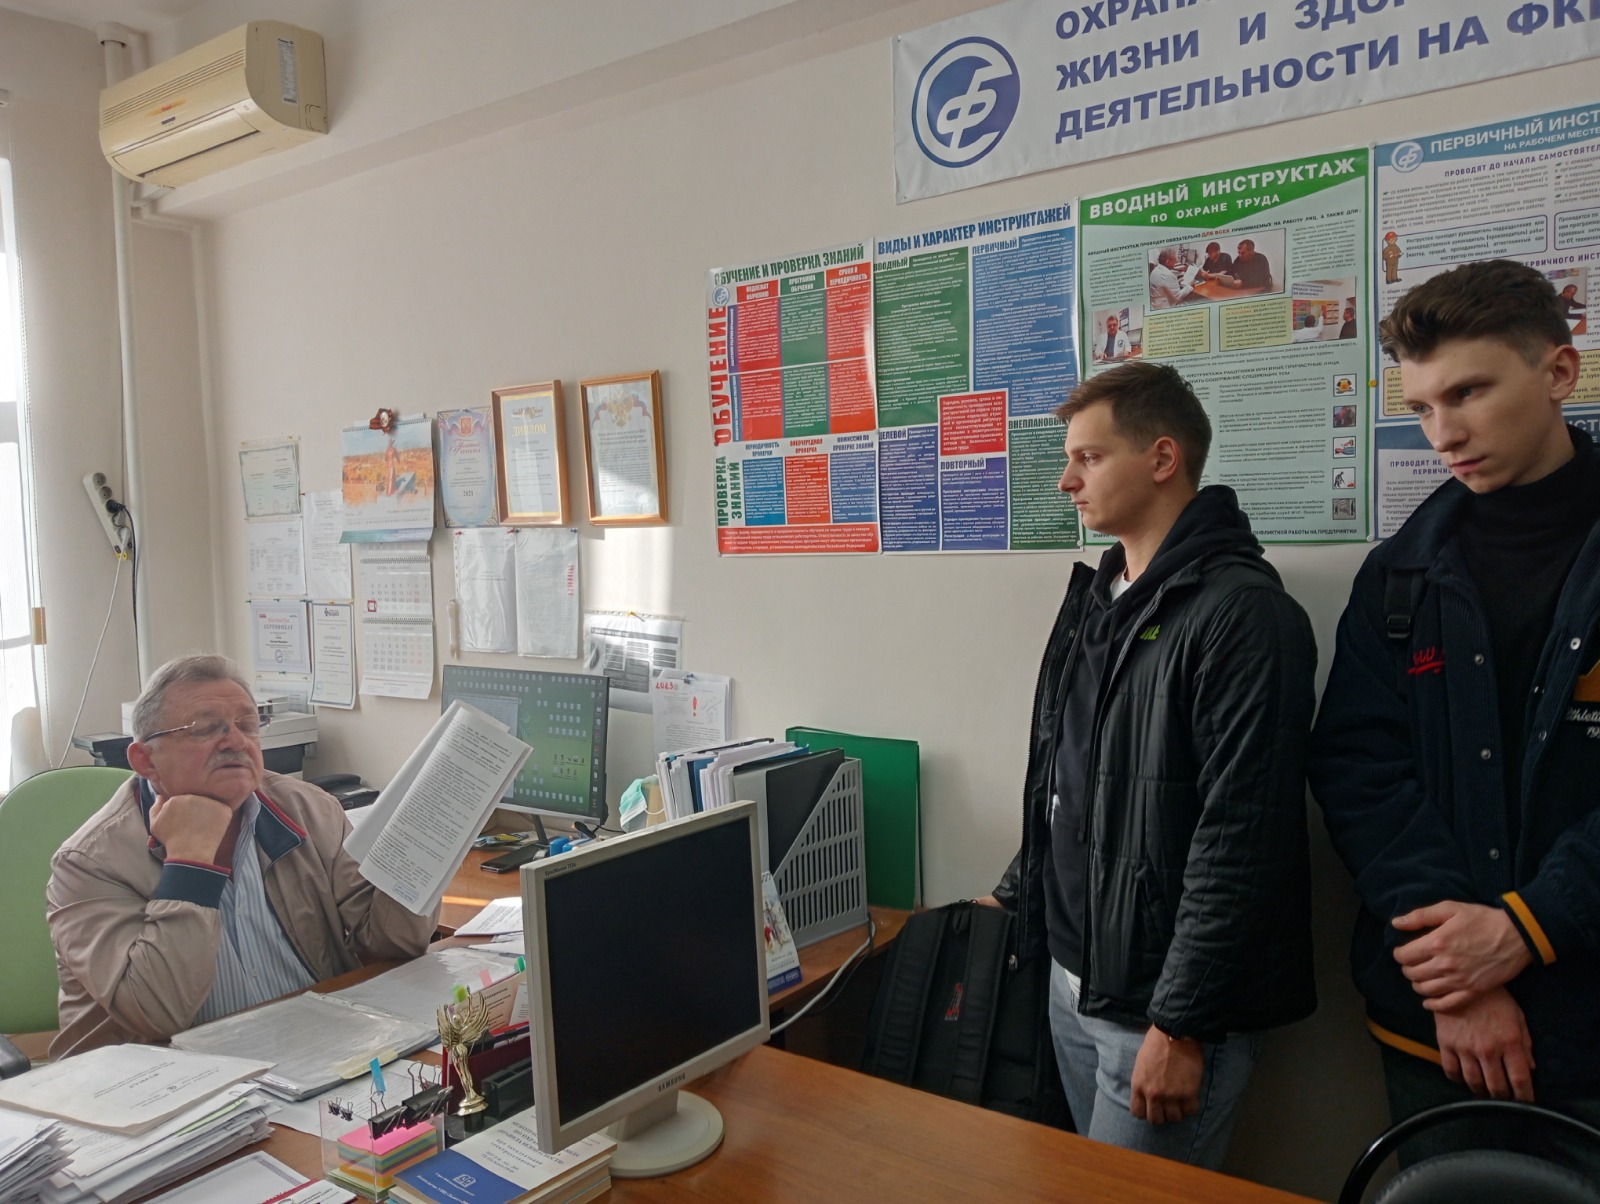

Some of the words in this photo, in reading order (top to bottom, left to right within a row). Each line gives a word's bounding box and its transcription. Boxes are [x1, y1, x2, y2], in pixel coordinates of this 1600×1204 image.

[1055, 0, 1210, 40] ОХРА
[1056, 29, 1199, 91] ЖИЗНИ
[1239, 12, 1266, 45] И
[1055, 34, 1399, 144] ДЕЯТЕЛЬНОСТИ
[1418, 15, 1490, 60] НА
[1430, 118, 1543, 154] ПЕРВИЧНЫЙ
[1504, 143, 1517, 151] НА
[1519, 134, 1565, 149] РАБОЧЕМ
[1444, 164, 1486, 177] ПРОВОДЯТ
[1489, 162, 1500, 171] ДО
[1503, 156, 1536, 168] НАЧАЛА
[1088, 184, 1189, 219] ВВОДНЫЙ
[1202, 157, 1355, 198] ИНСТРУКТАЖ
[1150, 212, 1167, 224] ПО
[1176, 202, 1228, 220] ОХРАНЕ
[1236, 193, 1280, 210] ТРУДА
[877, 236, 911, 256] ВИДЫ
[913, 233, 921, 248] И
[921, 222, 975, 247] ХАРАКТЕР
[977, 204, 1071, 236] ИНСТРУКТАЖЕЙ
[972, 236, 1018, 255] ПЕРВИЧНЫЙ
[714, 267, 761, 286] ОБУЧЕНИЕ
[761, 266, 769, 278] И
[770, 256, 821, 276] ПРОВЕРКА
[823, 243, 864, 267] ЗНАНИЙ
[873, 256, 909, 272] ВВОДНЫЙ
[1521, 255, 1575, 269] ЕРВИЧНОГО
[708, 306, 732, 447] ОБУЧЕНИЕ
[940, 458, 985, 470] ПОВТОРНЫЙ
[1389, 459, 1430, 468] ПРОВОДЯТ
[1432, 458, 1442, 466] НЕ
[715, 456, 729, 526] ПРОВЕРКА
[727, 462, 742, 520] ЗНАНИЙ
[1252, 528, 1287, 536] ОНФЛИКТНОЙ
[655, 681, 674, 690] 2023
[658, 1072, 686, 1093] SAMSUNG
